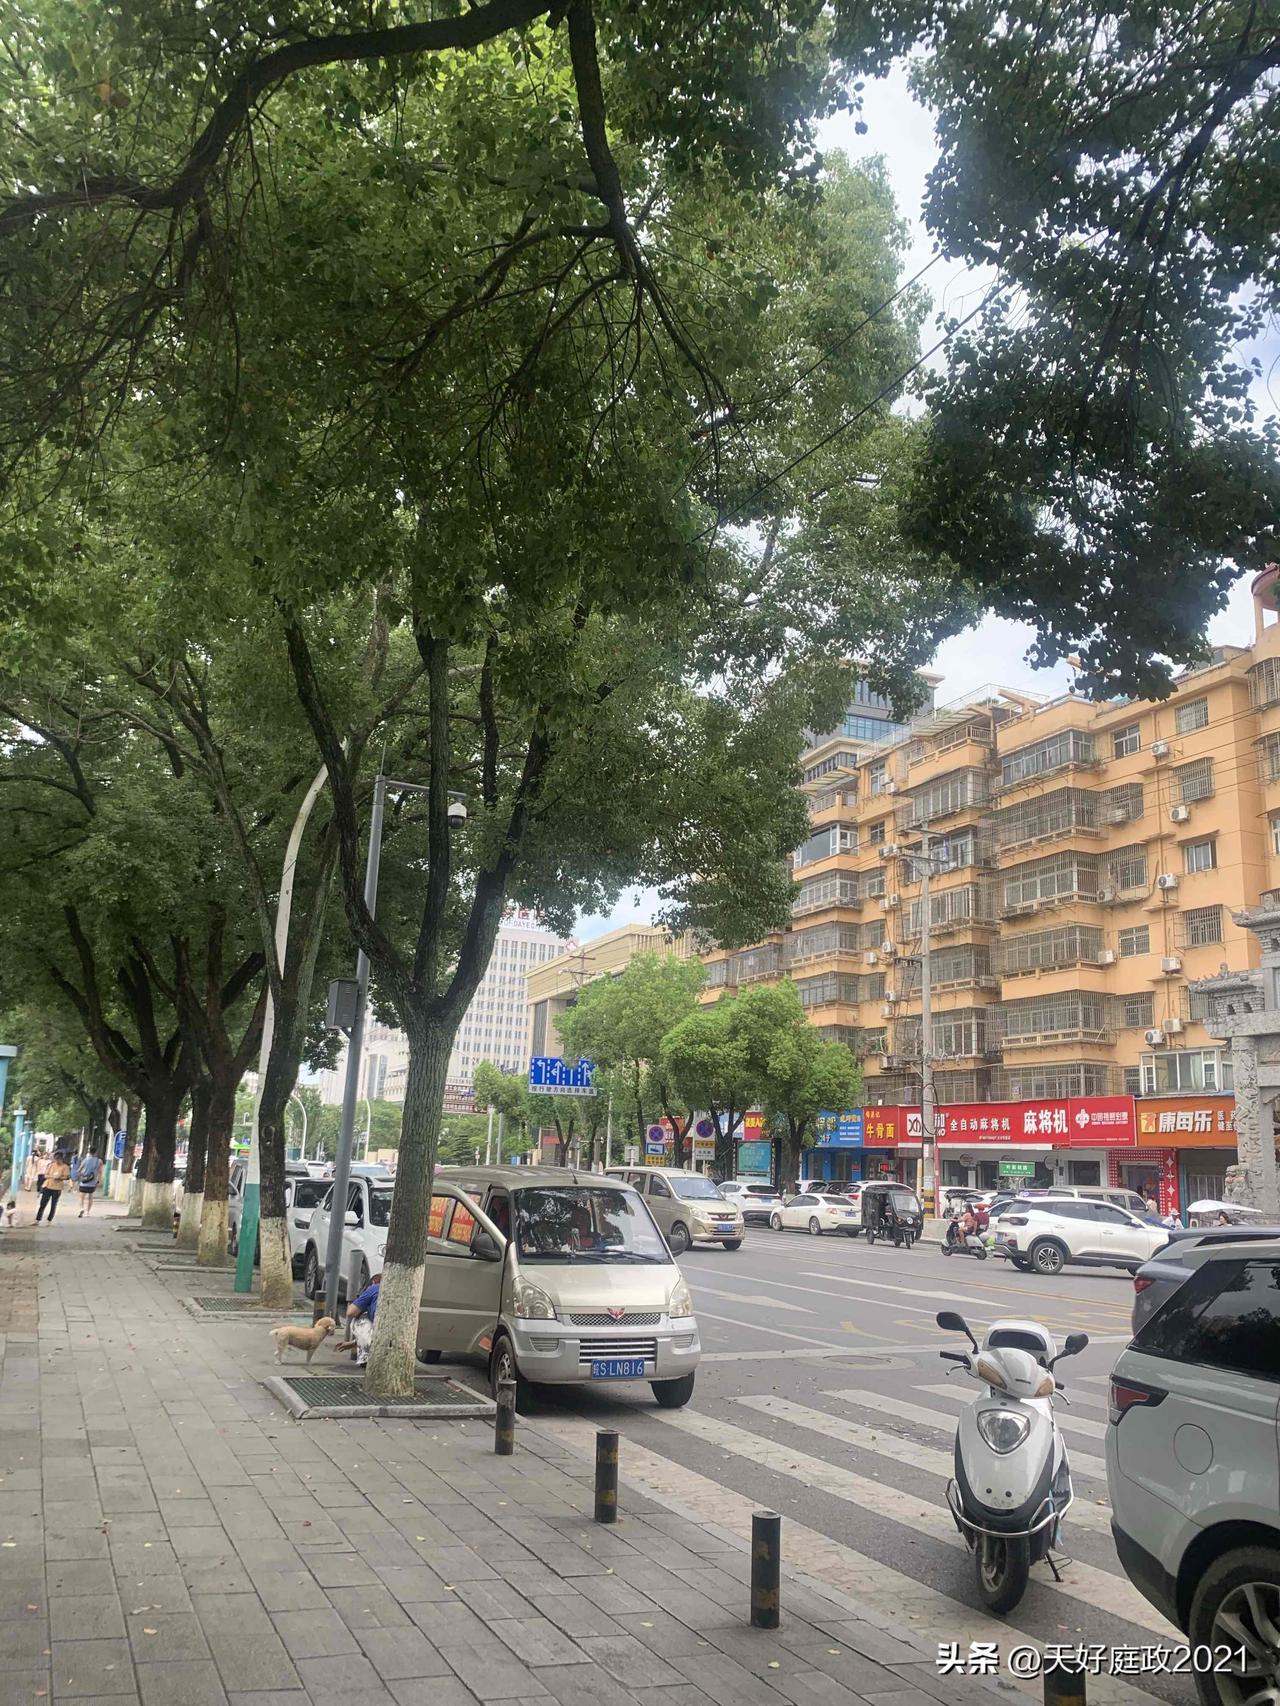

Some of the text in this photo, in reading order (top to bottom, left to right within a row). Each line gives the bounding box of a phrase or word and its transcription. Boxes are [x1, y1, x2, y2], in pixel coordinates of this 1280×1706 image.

[950, 1117, 1011, 1131] 全自动麻将机
[1023, 1108, 1069, 1134] 麻将机
[866, 1122, 895, 1139] 牛骨面
